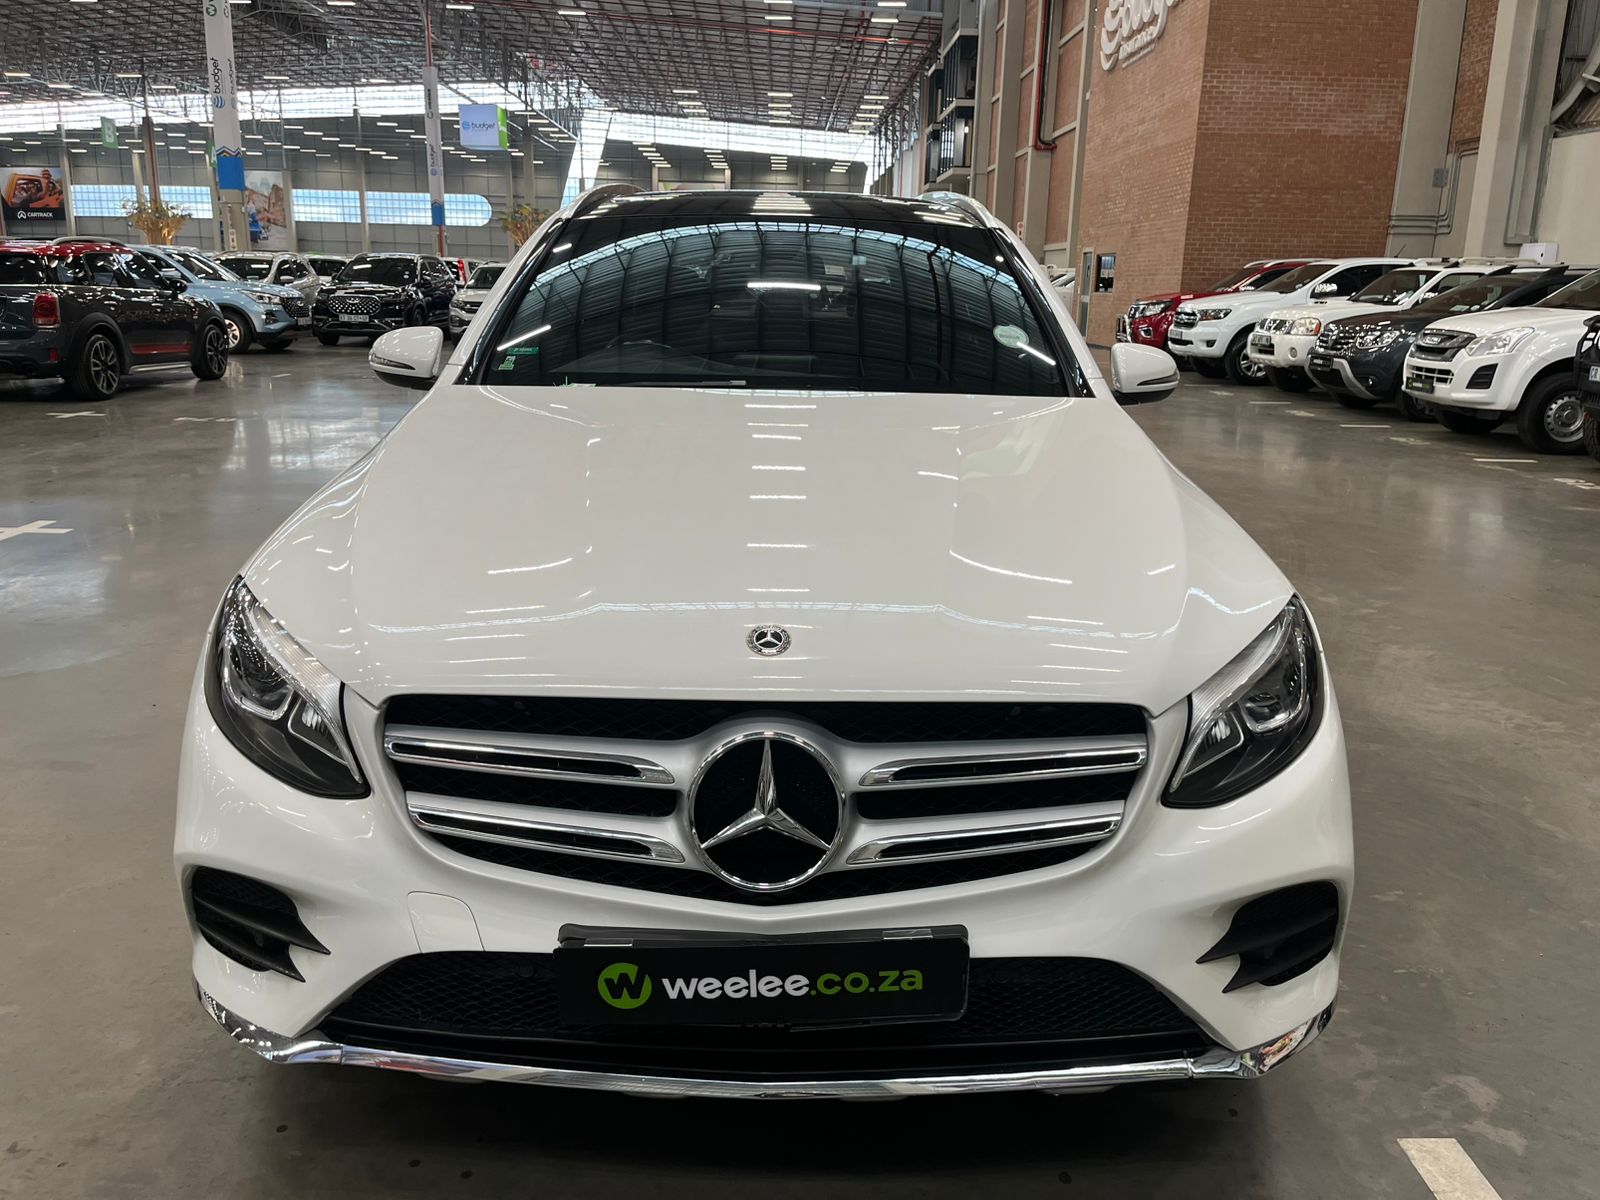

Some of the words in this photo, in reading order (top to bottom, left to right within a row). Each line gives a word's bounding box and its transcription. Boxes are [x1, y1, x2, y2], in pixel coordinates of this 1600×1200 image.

[210, 57, 222, 94] budget
[472, 121, 496, 131] budget
[661, 969, 924, 1000] weelee.co.za
